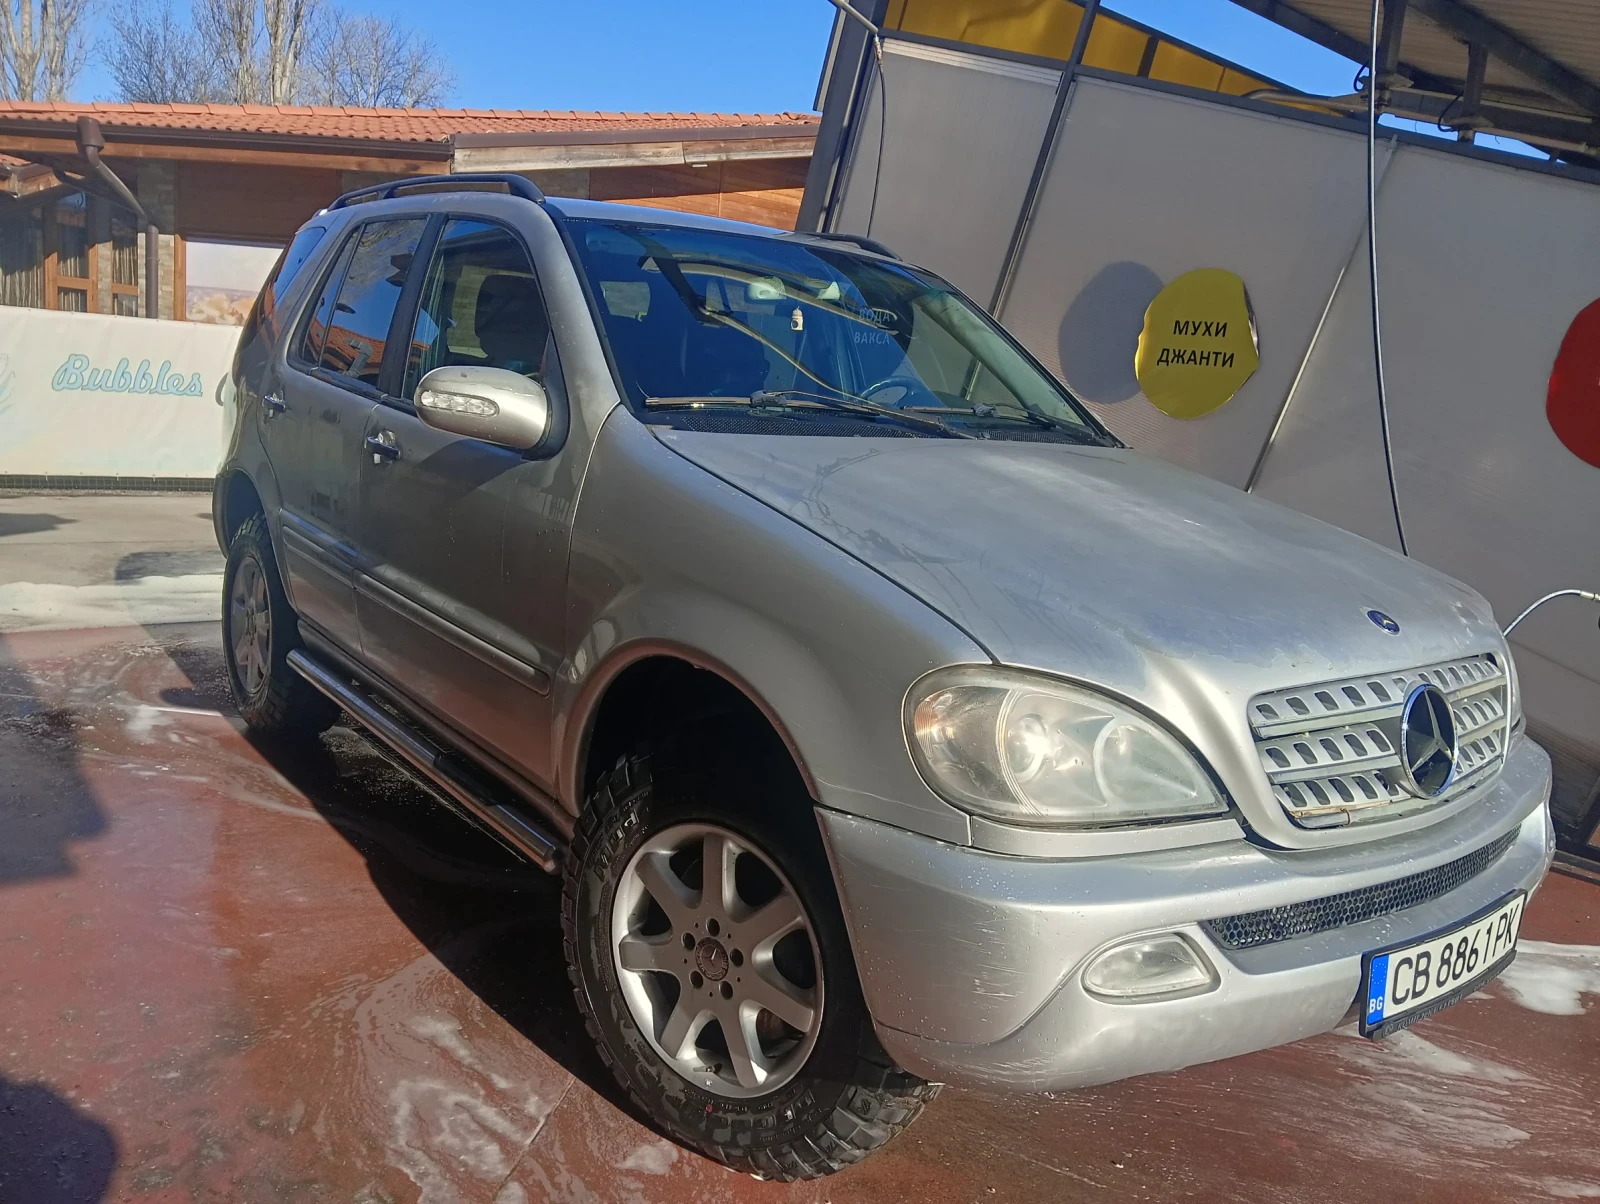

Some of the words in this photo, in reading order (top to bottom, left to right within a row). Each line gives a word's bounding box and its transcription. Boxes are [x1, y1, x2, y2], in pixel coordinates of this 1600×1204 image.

[854, 331, 890, 345] ВАКСА
[1173, 320, 1228, 338] МУХИ
[1156, 348, 1235, 368] ДЖАНТИ
[51, 353, 203, 397] Bubbles
[1369, 998, 1384, 1014] BG
